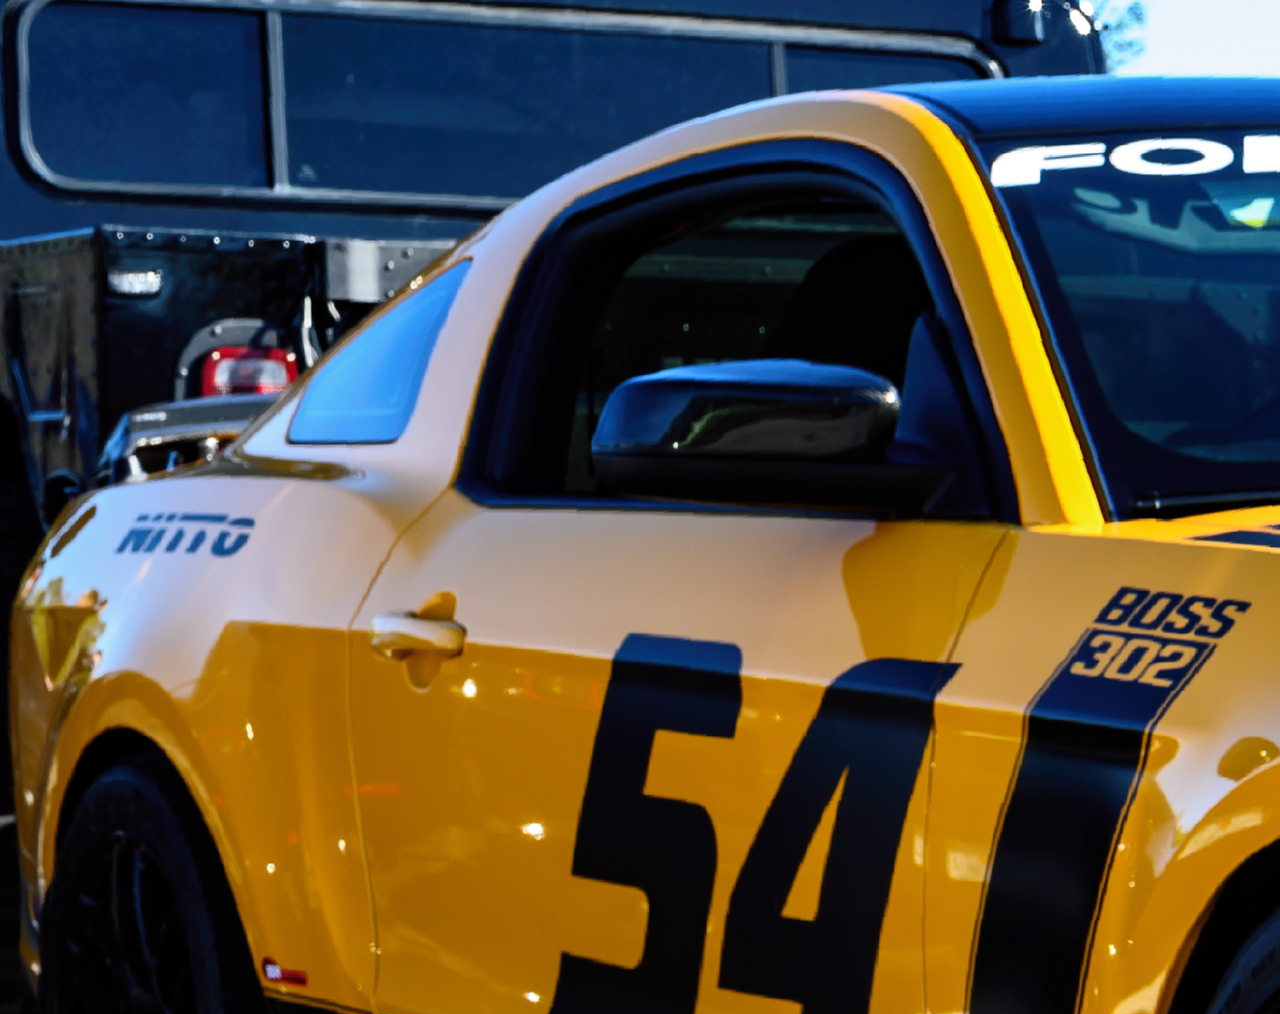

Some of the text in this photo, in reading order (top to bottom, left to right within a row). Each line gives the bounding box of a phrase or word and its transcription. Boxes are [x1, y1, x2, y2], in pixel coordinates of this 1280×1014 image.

[116, 512, 257, 558] NITTO
[1092, 586, 1253, 639] BOSS
[1069, 633, 1199, 688] 302
